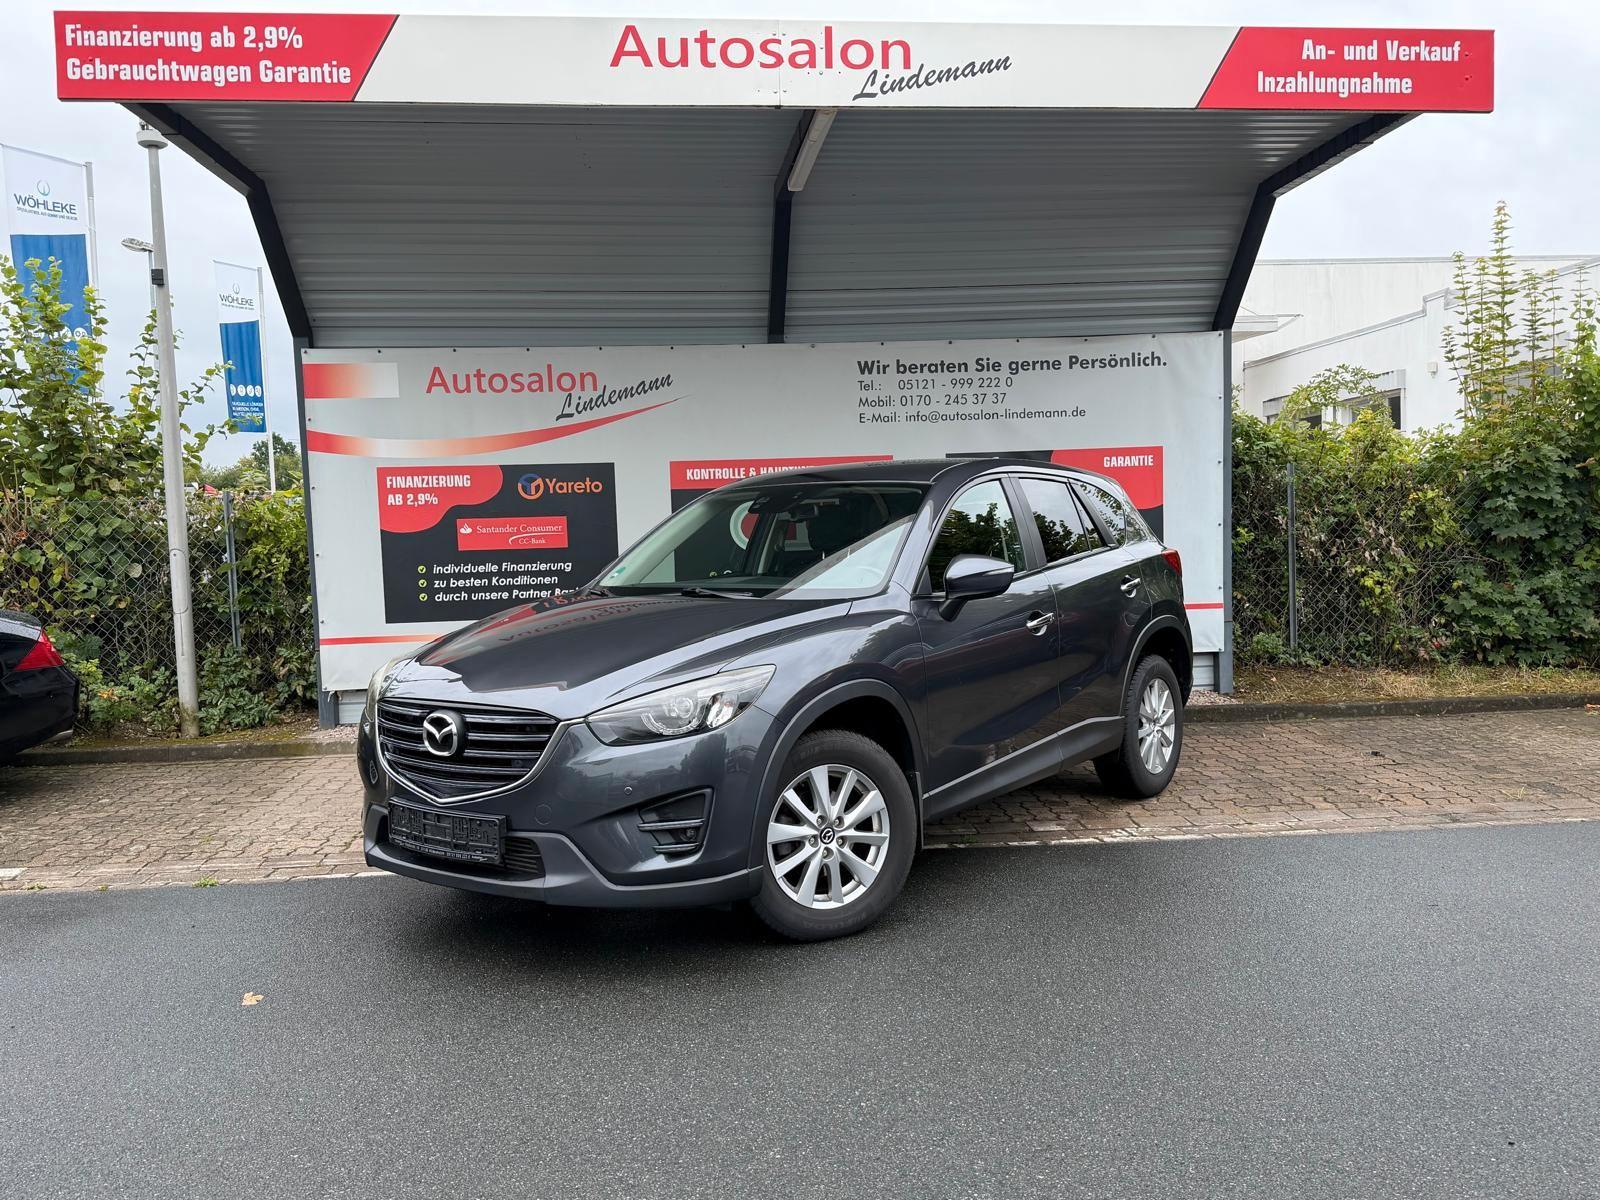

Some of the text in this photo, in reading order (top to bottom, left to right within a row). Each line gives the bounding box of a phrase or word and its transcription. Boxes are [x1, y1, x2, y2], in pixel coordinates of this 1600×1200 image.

[65, 24, 303, 52] Finanzierung ab 2,9%
[609, 24, 912, 70] Autosalon
[1301, 39, 1461, 62] An- und Verkauf
[66, 57, 351, 87] Gebrauchtwagen Garantie
[852, 55, 1012, 102] Lindemann
[1257, 70, 1413, 98] Inzahlungnahme
[14, 193, 77, 215] WÖHLEKE
[857, 351, 1168, 377] Wir beraten Sie gerne Persönlich.
[425, 363, 598, 394] Autosalon
[858, 380, 882, 392] Tel.:
[898, 379, 936, 391] 05121
[950, 378, 973, 390] 999
[977, 376, 1001, 389] 222
[1005, 376, 1013, 388] 0
[555, 373, 673, 422] Lindemann
[858, 395, 896, 408] Mobil:
[900, 395, 931, 407] 0170
[945, 394, 968, 406] 245
[972, 393, 988, 405] 37
[991, 392, 1007, 404] 37
[859, 406, 1086, 424] E-Mail: info@autosalon-lindemann.de
[1103, 455, 1154, 468] GARANTIE
[386, 475, 471, 489] FINANZIERUNG
[686, 467, 746, 481] KONTROLLE
[749, 466, 756, 477] &
[545, 477, 603, 494] Yareto
[387, 493, 438, 507] AB 2,9%
[476, 523, 562, 534] Santander Consumer
[518, 537, 546, 545] CC-Bank
[433, 561, 573, 575] individuelle Finanzierung
[434, 575, 558, 588] zu besten Konditionen
[435, 591, 468, 602] durch
[471, 591, 509, 601] unsere
[512, 588, 551, 599] Partner
